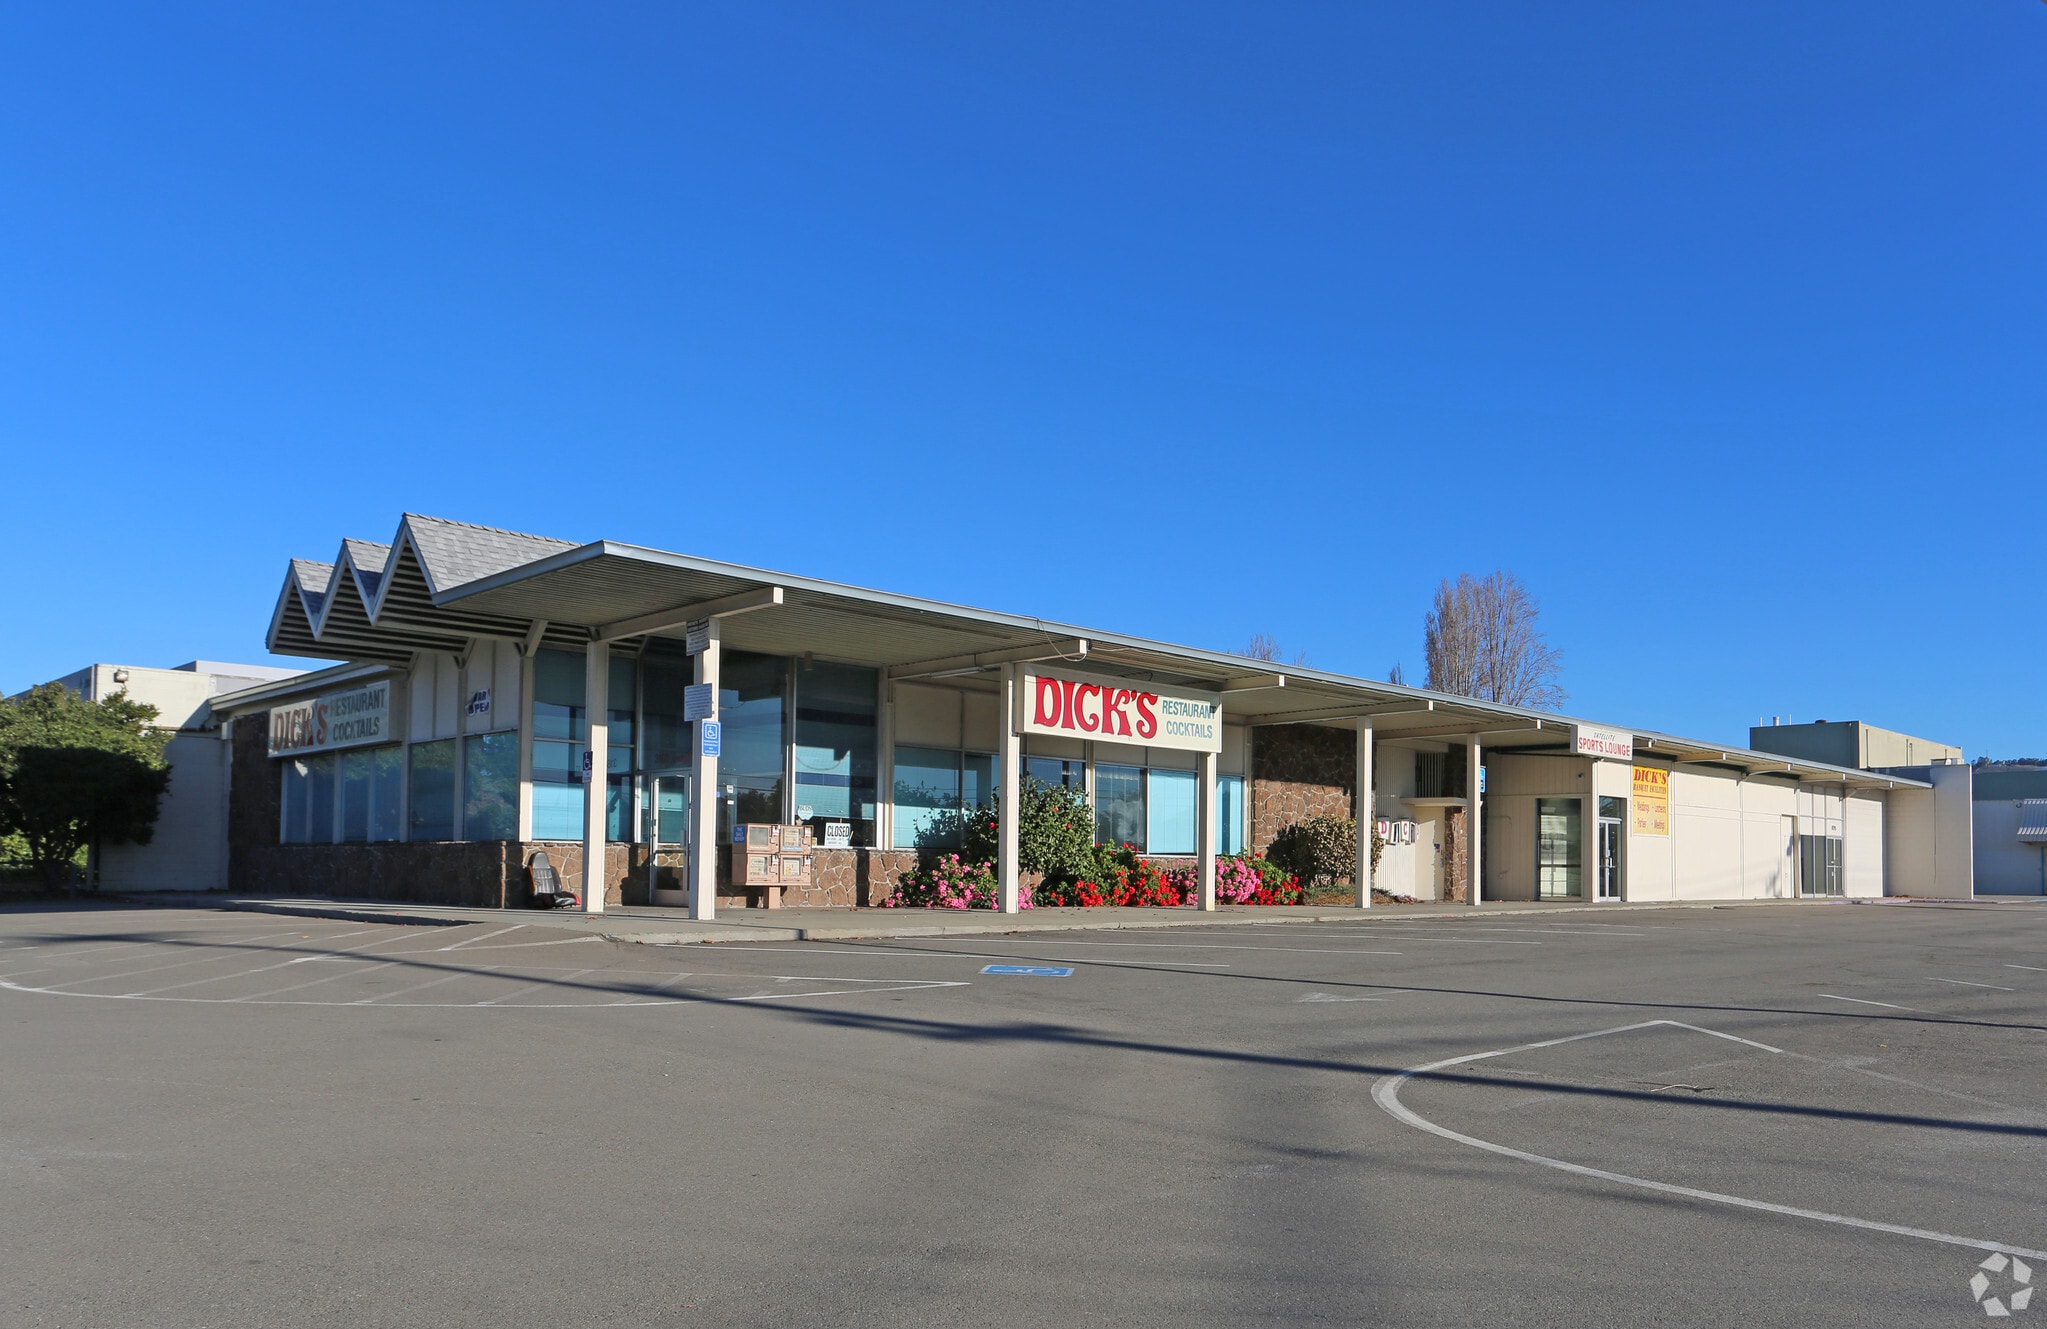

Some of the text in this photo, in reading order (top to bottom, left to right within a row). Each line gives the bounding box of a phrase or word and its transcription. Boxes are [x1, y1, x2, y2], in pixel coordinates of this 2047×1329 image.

[1033, 675, 1217, 739] DICK'S RESTAURANT
[273, 688, 386, 750] DICK'S RESTAURANT
[332, 716, 380, 742] COCKTAILS
[1166, 720, 1213, 740] COCKTAILS
[1578, 736, 1631, 757] SPORTS LOUNGE
[1633, 768, 1667, 785] DICK'S
[827, 825, 850, 838] CLOSED
